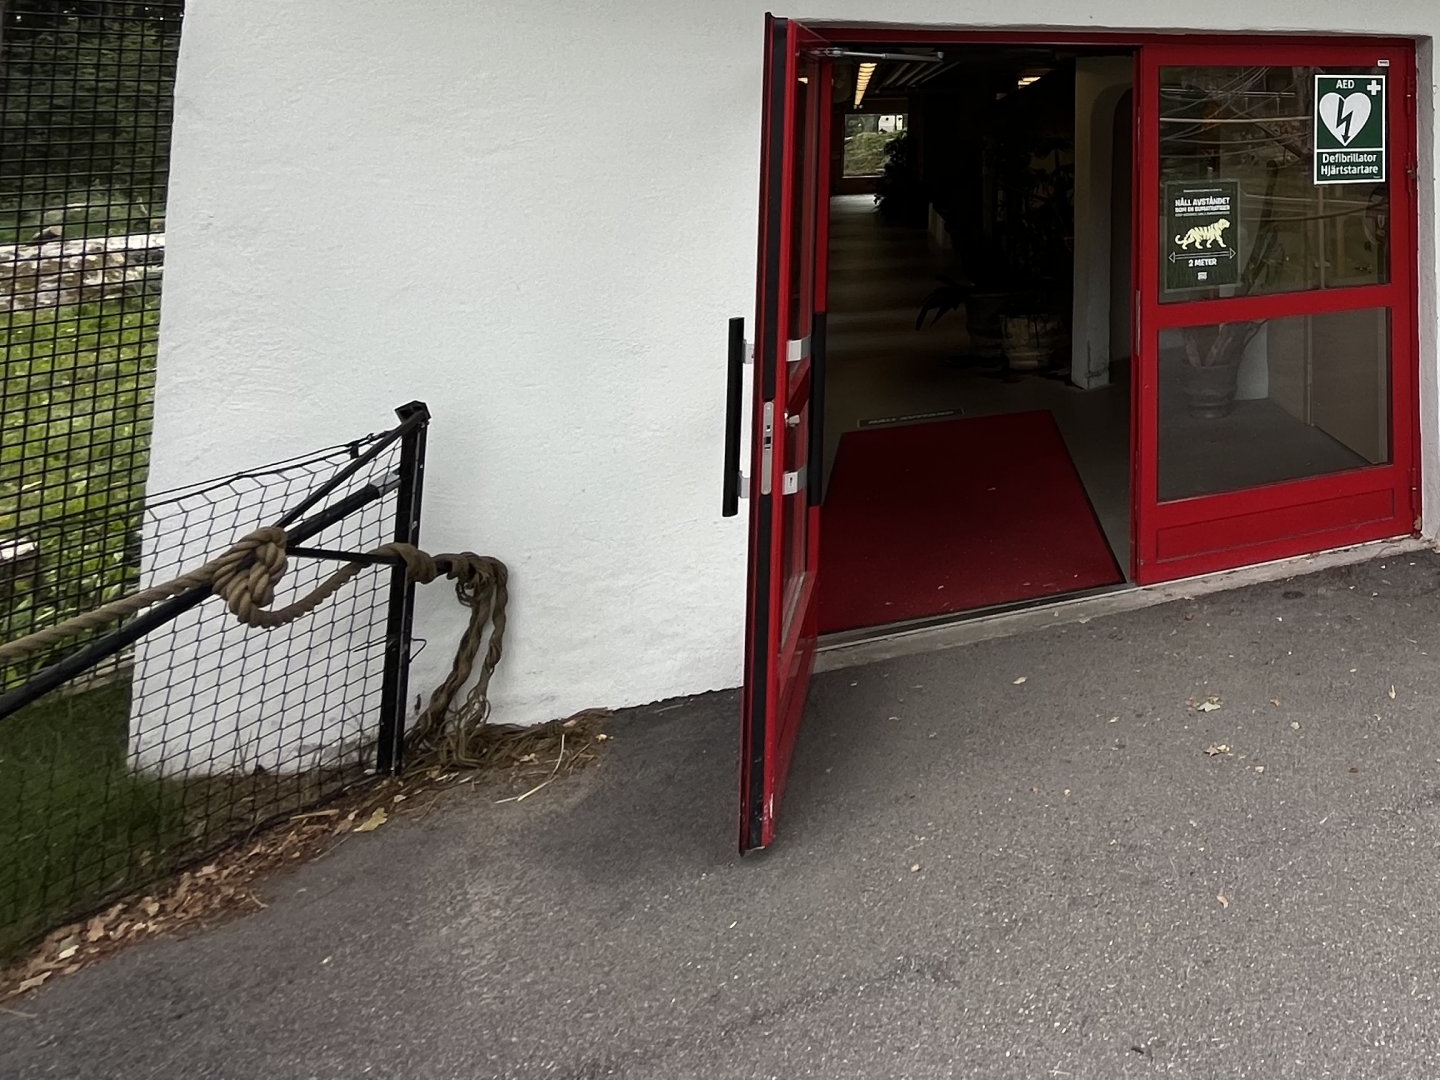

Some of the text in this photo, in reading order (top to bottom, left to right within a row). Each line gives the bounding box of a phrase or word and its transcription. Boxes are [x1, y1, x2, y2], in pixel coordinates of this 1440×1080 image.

[1336, 79, 1355, 89] AED
[1322, 153, 1377, 163] Defibrillator
[1321, 165, 1379, 176] Hjärtstartare
[1175, 197, 1192, 207] HÅLL
[1188, 258, 1217, 267] 2 METER
